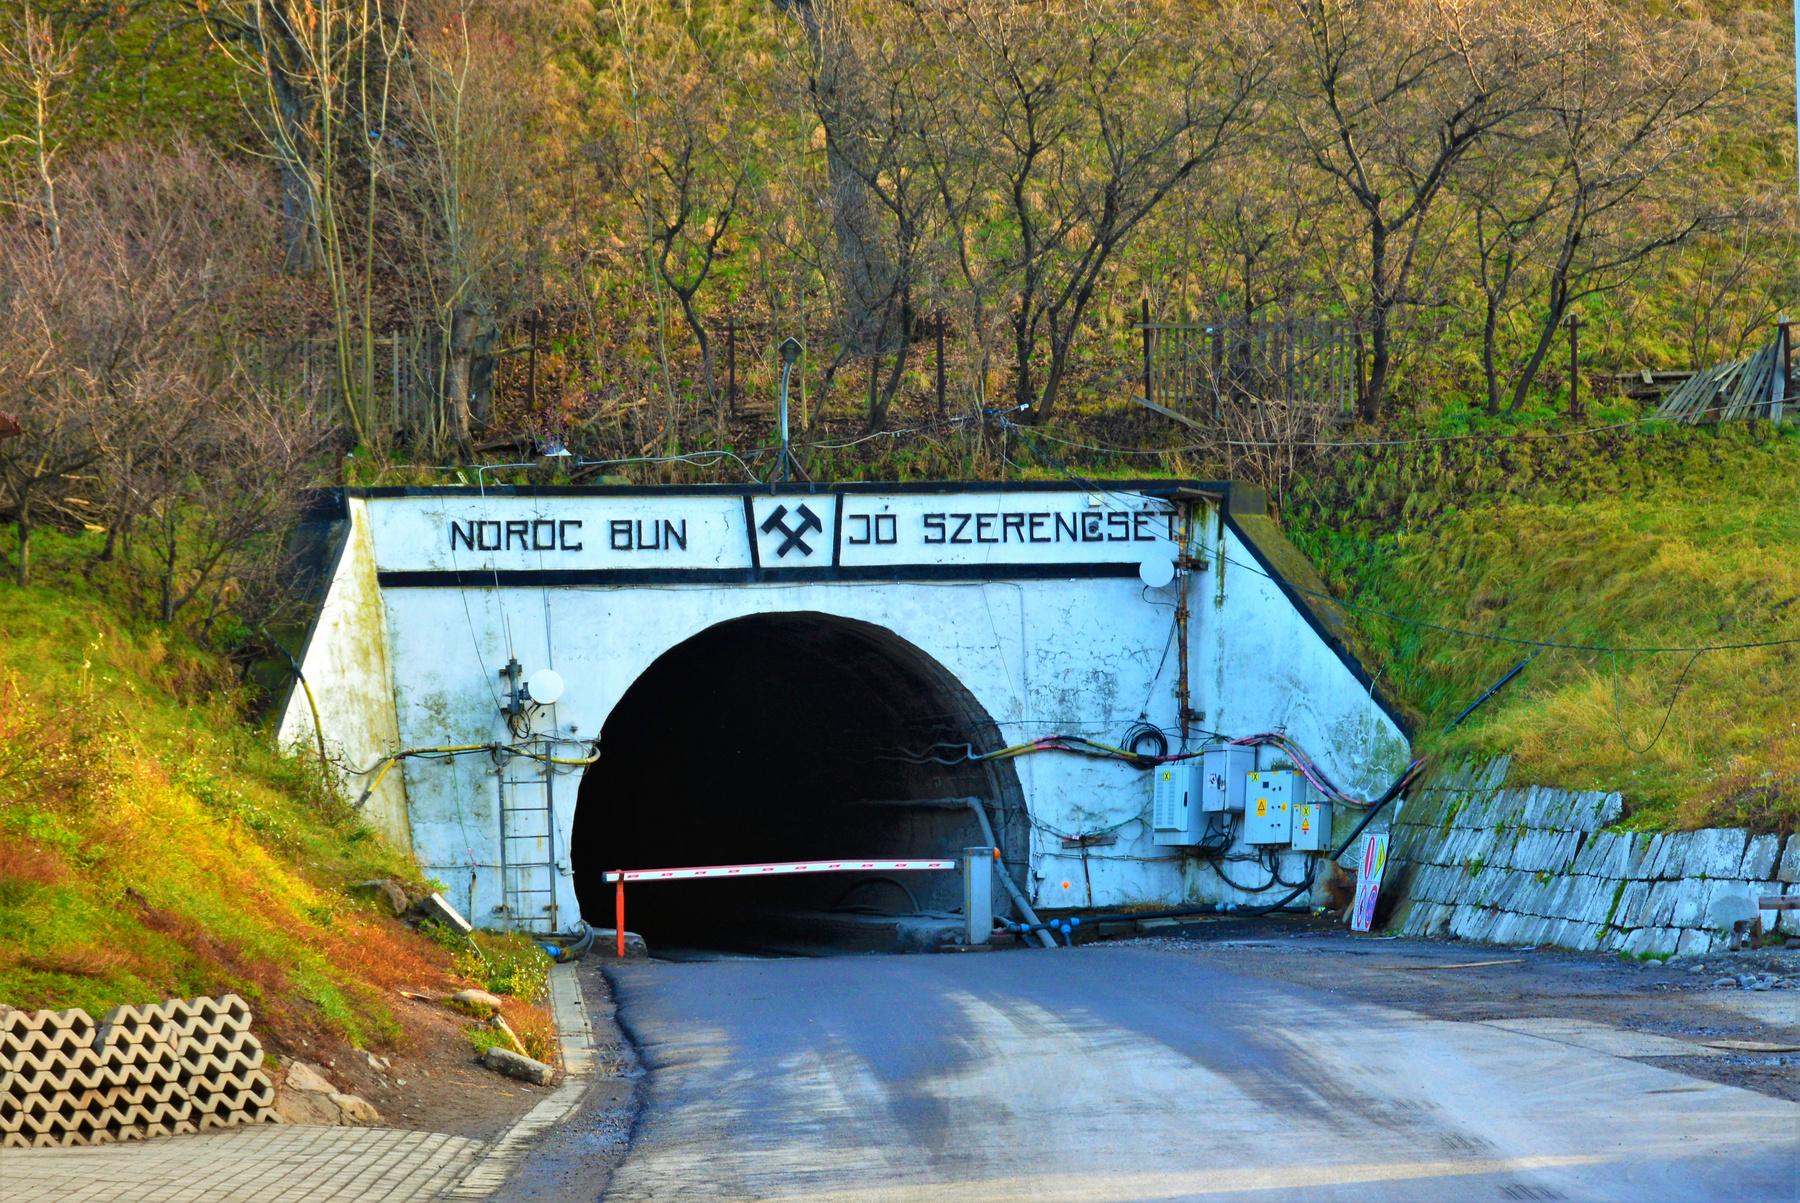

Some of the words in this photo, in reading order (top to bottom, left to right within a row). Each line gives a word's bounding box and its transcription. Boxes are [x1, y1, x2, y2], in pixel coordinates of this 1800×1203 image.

[451, 519, 583, 551] NOROC
[610, 518, 687, 551] BUN
[849, 505, 897, 544] JÓ
